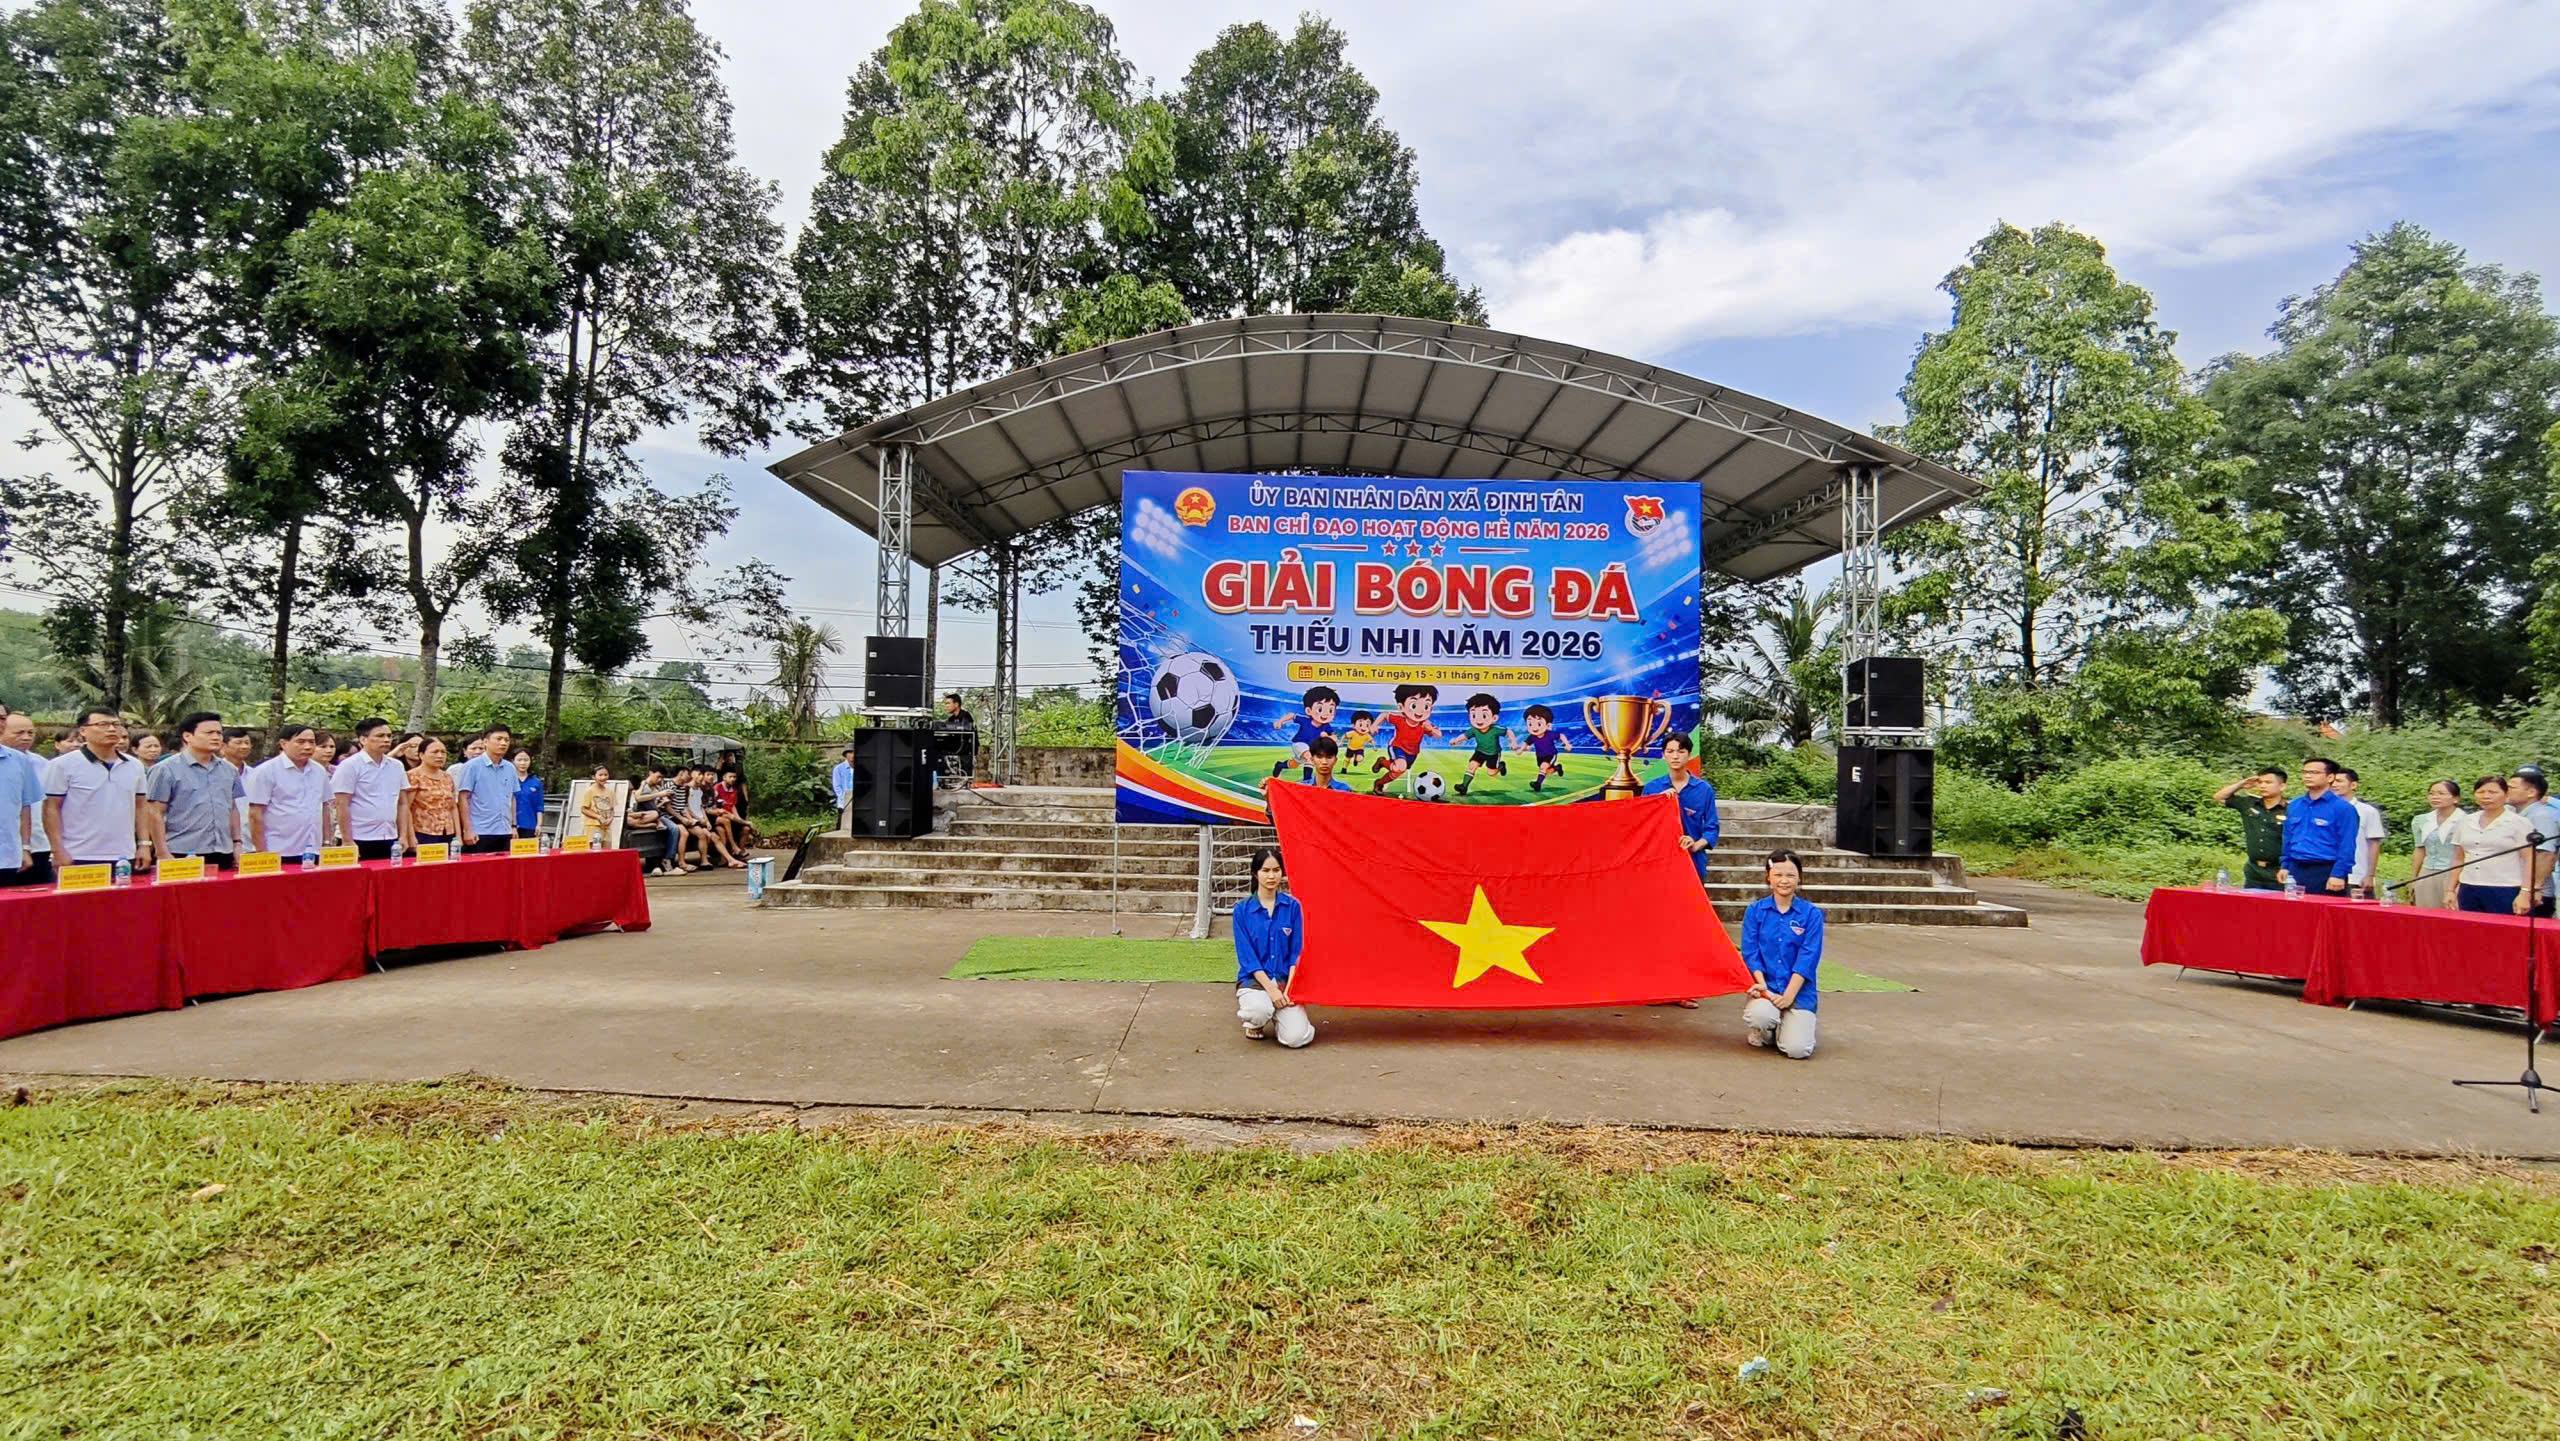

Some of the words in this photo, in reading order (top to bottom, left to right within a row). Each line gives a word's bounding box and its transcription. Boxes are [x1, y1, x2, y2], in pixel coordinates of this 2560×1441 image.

[1251, 481, 1279, 505] ỦY
[1286, 488, 1328, 507] BAN
[1334, 485, 1393, 509] NHÂN
[1399, 486, 1444, 511] DÂN
[1449, 488, 1479, 511] XÃ
[1486, 493, 1537, 515] ĐỊNH
[1542, 489, 1583, 512] TÂN
[1228, 514, 1270, 534] BAN
[1274, 512, 1310, 535] CHỈ
[1314, 518, 1358, 540] ĐẠO
[1362, 519, 1415, 541] HOẠT
[1421, 517, 1479, 542] ĐỘNG
[1484, 516, 1510, 539] HÈ
[1515, 518, 1560, 540] NĂM
[1564, 523, 1609, 541] 2026
[1202, 547, 1335, 615] GIẢI
[1355, 558, 1534, 618] BÓNG
[1549, 562, 1640, 622] ĐÁ
[1250, 616, 1350, 654] THIẾU
[1361, 627, 1422, 655] NHI
[1432, 623, 1511, 658] NĂM
[1521, 630, 1602, 659] 2026
[1319, 668, 1342, 679] Định
[1346, 668, 1368, 678] Tân,
[1371, 668, 1384, 678] Từ
[1387, 670, 1411, 680] ngày
[1415, 670, 1426, 679] 15
[1436, 671, 1447, 679] 31
[1451, 671, 1480, 681] tháng
[1483, 671, 1489, 680] 7
[1492, 671, 1514, 680] năm
[1517, 672, 1541, 680] 2026
